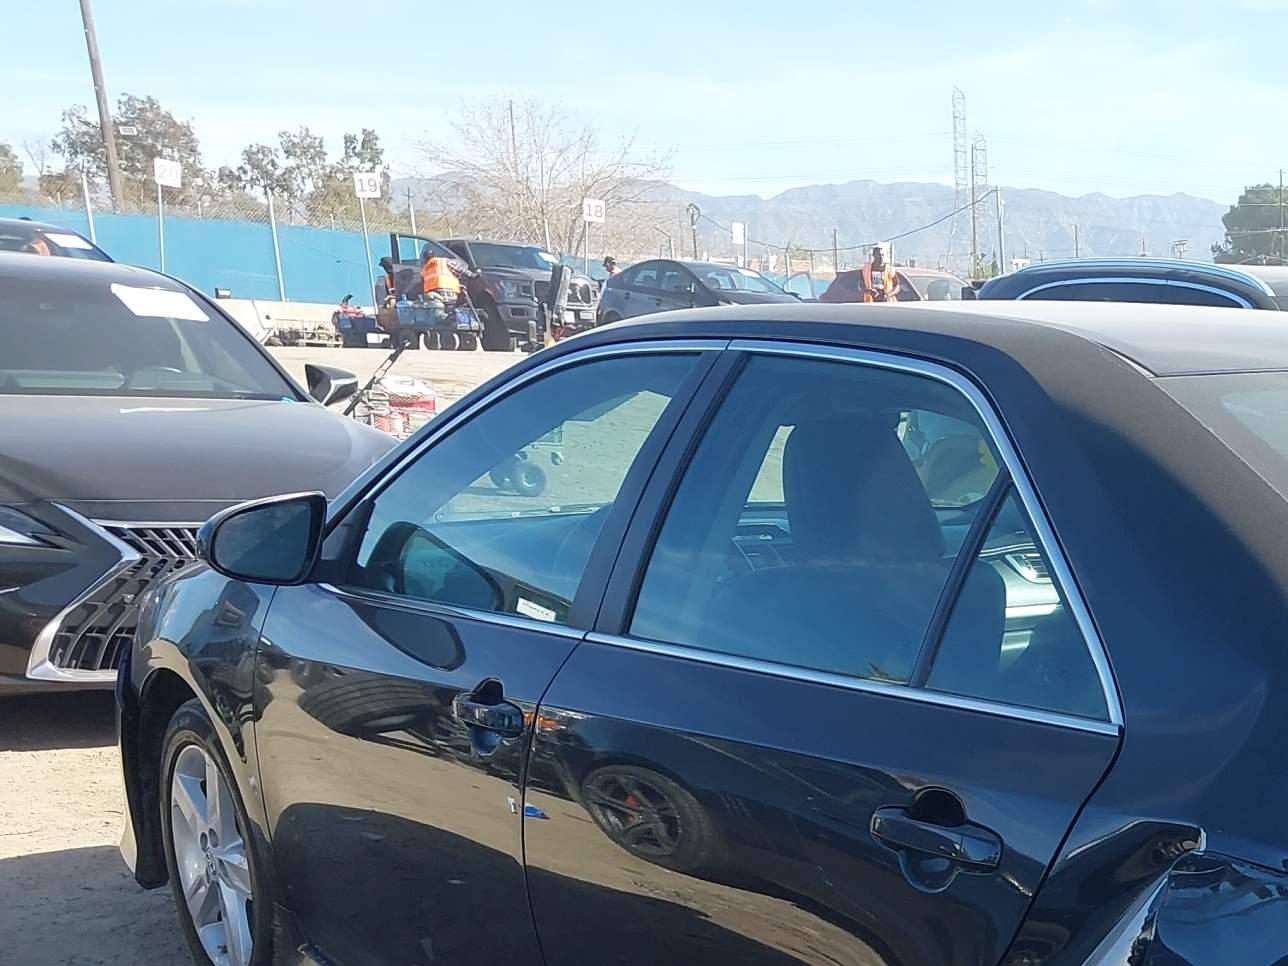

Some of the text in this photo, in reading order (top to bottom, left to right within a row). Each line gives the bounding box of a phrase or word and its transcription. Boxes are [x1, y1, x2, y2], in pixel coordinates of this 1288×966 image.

[159, 163, 178, 180] 20
[358, 178, 378, 193] 19
[585, 203, 603, 218] 18
